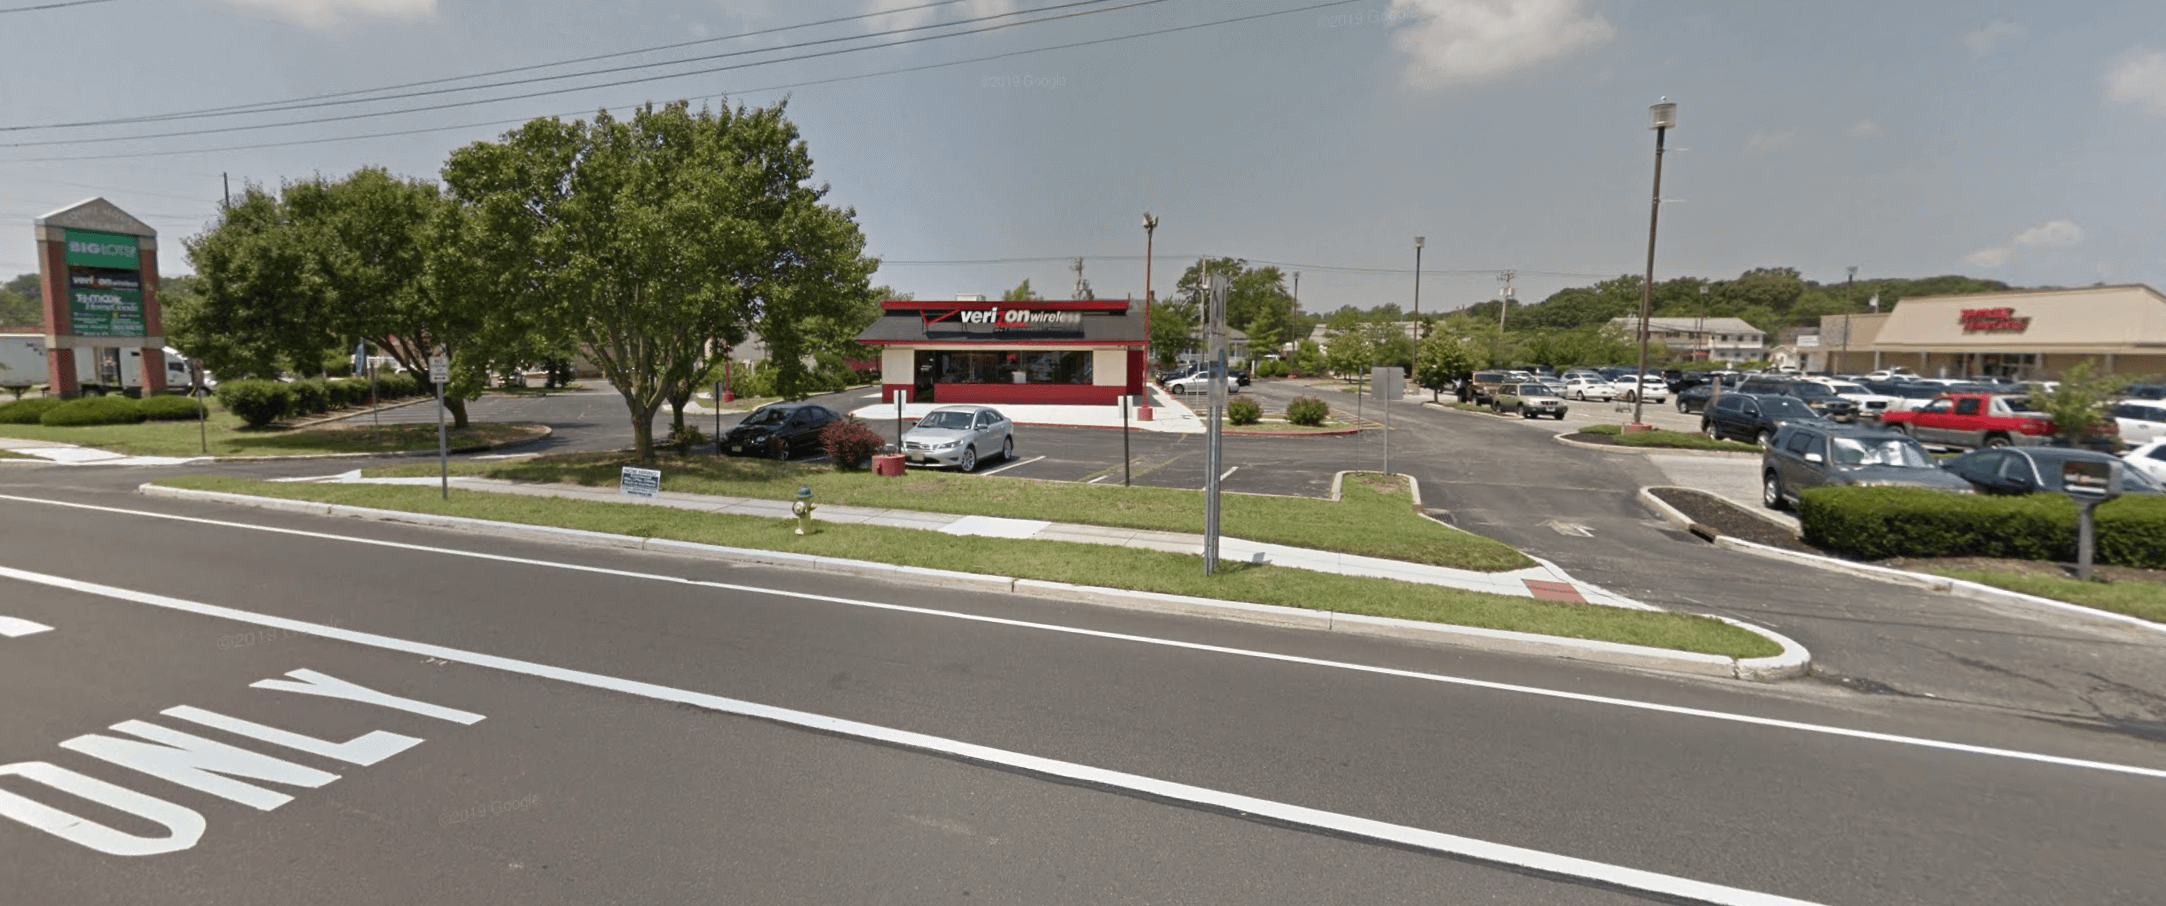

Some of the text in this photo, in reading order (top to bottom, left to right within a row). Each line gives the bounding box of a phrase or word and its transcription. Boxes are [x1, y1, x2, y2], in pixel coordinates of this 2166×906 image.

[69, 241, 100, 254] BIG
[961, 307, 1030, 327] verizon
[0, 667, 487, 857] ONLY
